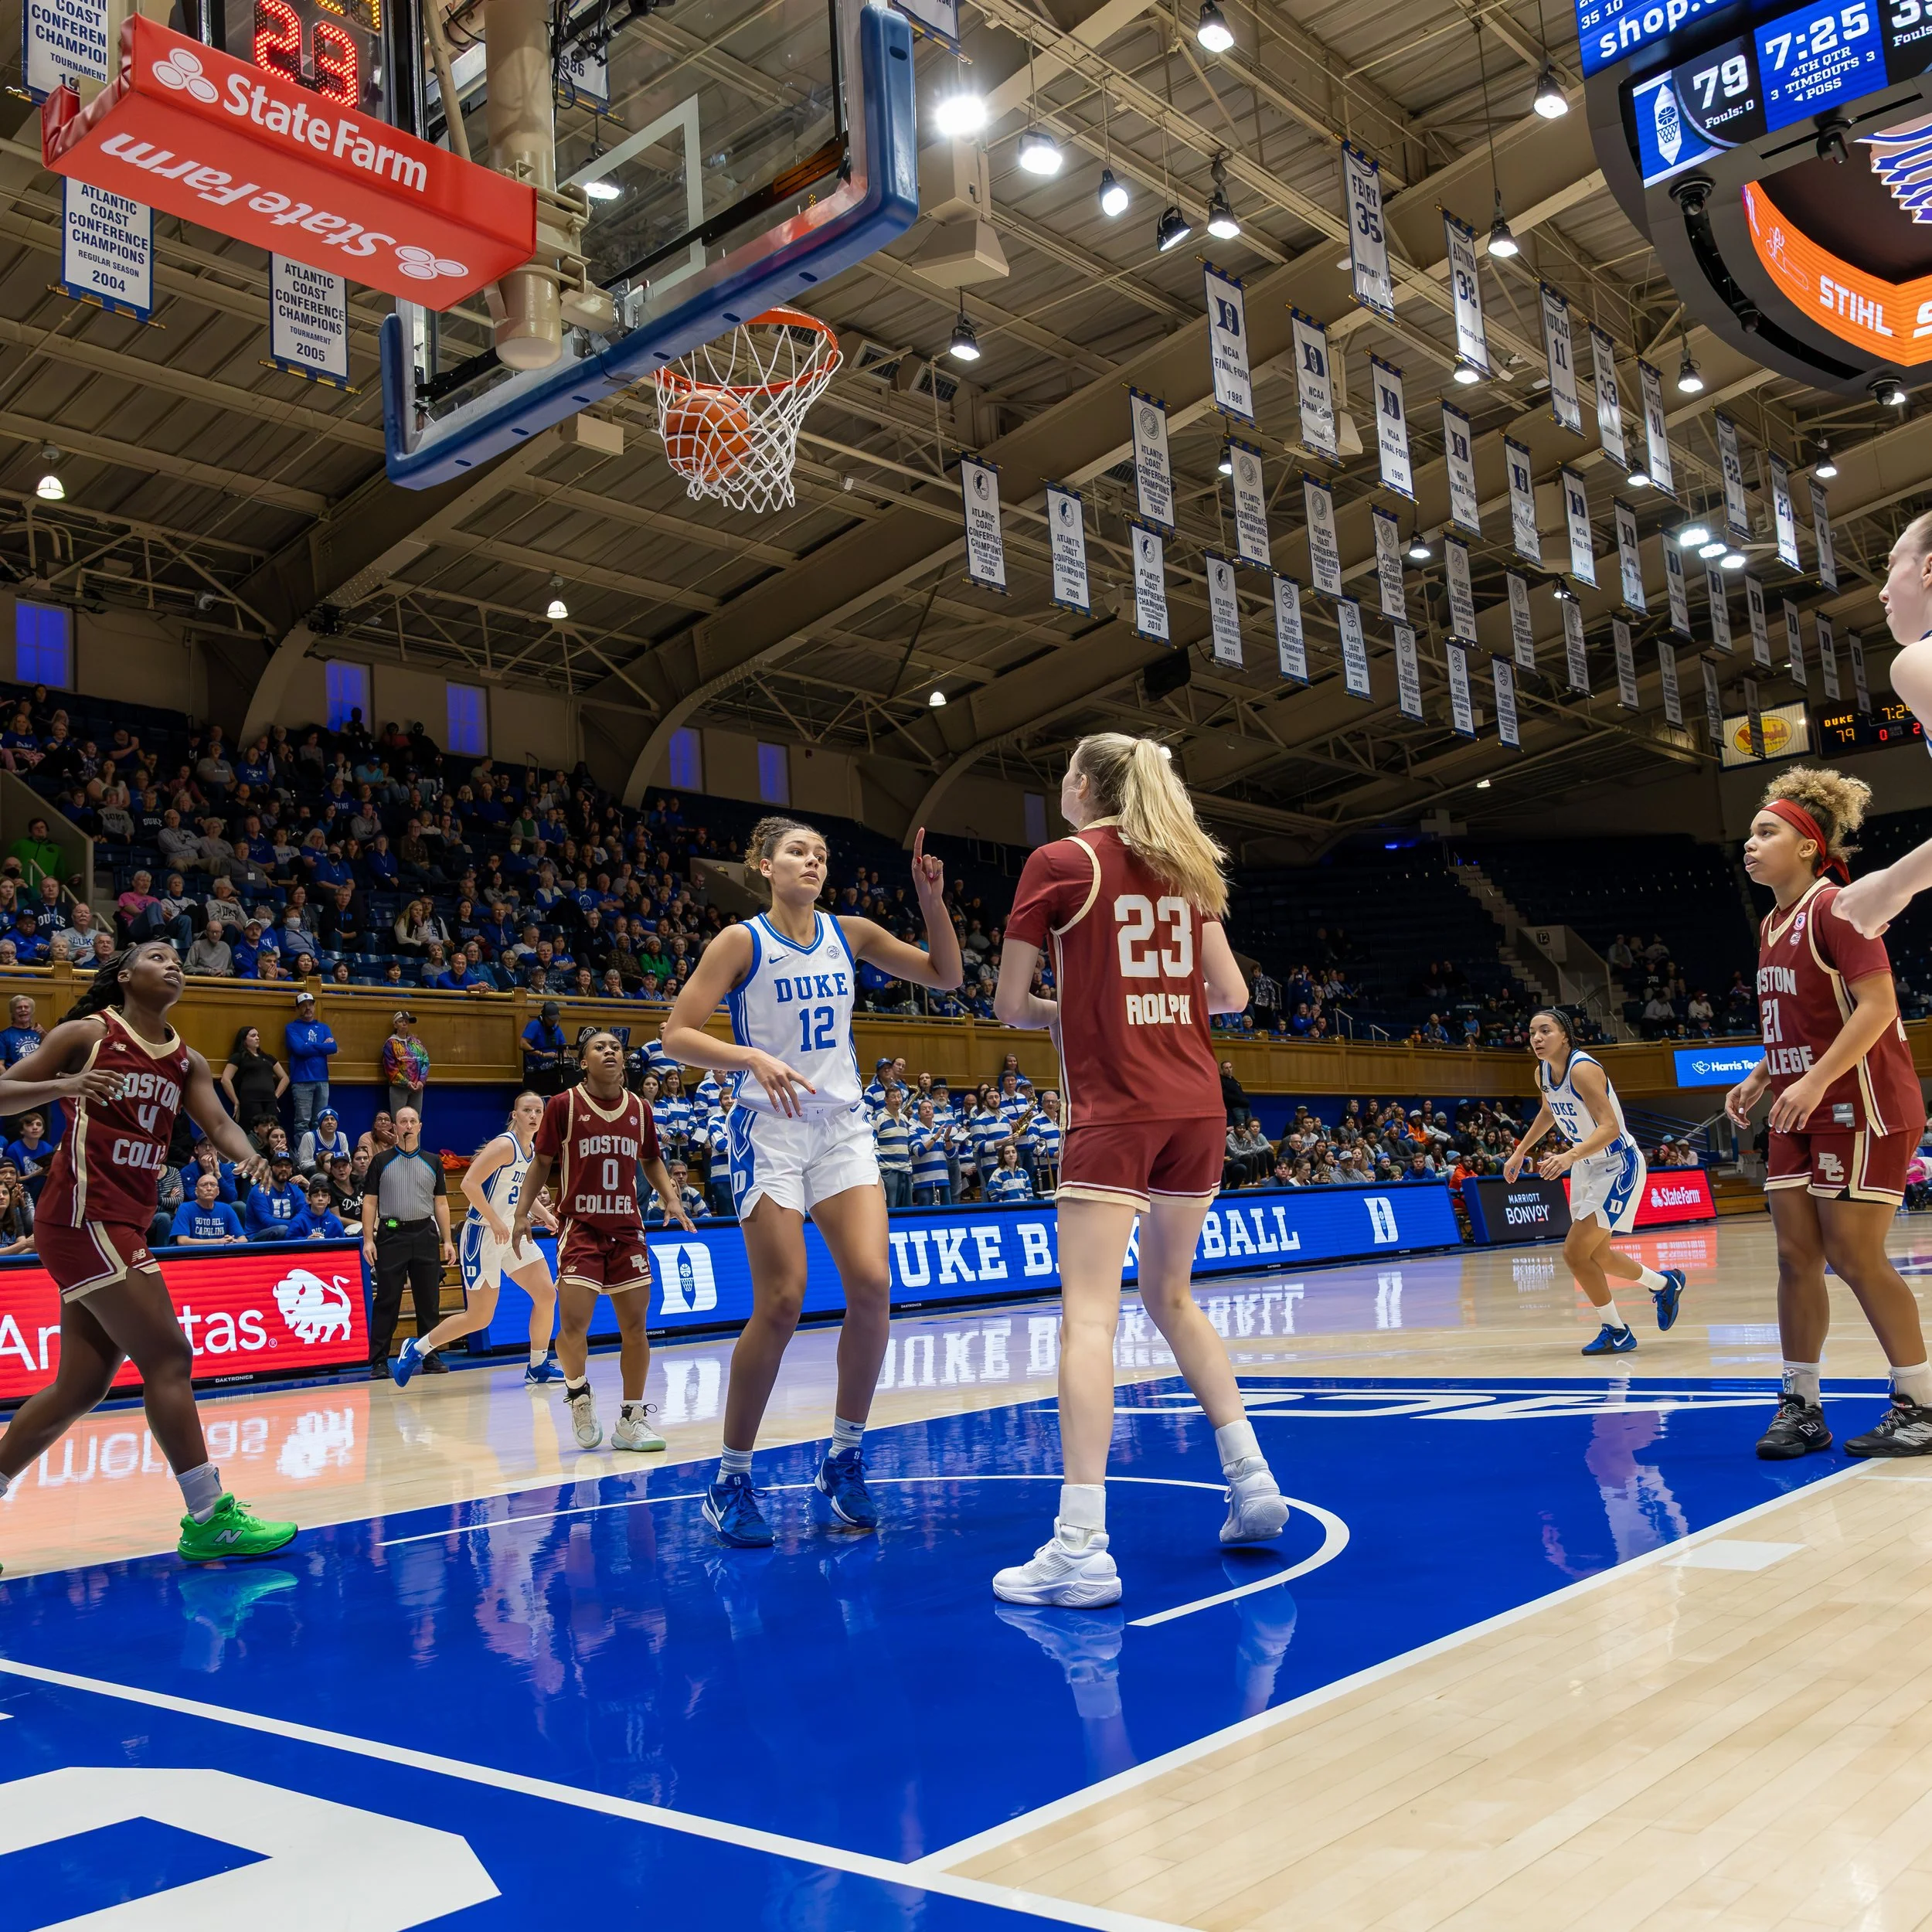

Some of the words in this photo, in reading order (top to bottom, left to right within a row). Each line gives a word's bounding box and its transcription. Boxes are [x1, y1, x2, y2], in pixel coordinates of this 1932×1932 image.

[56, 0, 101, 26] COAST
[1581, 14, 1600, 30] 35
[1765, 2, 1870, 71] 7:25
[50, 53, 107, 80] TOURNAMENT
[1791, 59, 1819, 77] 4TH
[1821, 46, 1852, 66] QTR
[1692, 54, 1750, 110] 79
[1770, 90, 1780, 100] 3
[1785, 58, 1859, 94] TIMEOUTS
[1866, 51, 1876, 63] 3
[1805, 79, 1842, 100] POSS
[1706, 104, 1743, 129] Fouls:
[1745, 99, 1754, 111] 0
[81, 184, 138, 215] ATLANTIC
[90, 202, 129, 227] COAST
[1355, 202, 1383, 243] 35
[69, 211, 148, 250] CONFERENCE
[72, 228, 145, 265] CHAMPIONS
[78, 250, 111, 267] REGULAR
[113, 261, 139, 277] SEASON
[92, 270, 126, 293] 2004
[284, 264, 335, 289] ATLANTIC
[292, 281, 327, 301] COAST
[1456, 270, 1478, 308] 32
[275, 288, 345, 321] CONFERENCE
[1819, 274, 1893, 337] STIHL
[278, 304, 342, 335] CHAMPIONS
[290, 325, 332, 345] TOURNAMENT
[296, 342, 325, 362] 2005
[1223, 345, 1240, 361] NCAA
[1553, 338, 1568, 370] 11
[1214, 358, 1233, 374] FINAL
[1226, 390, 1243, 405] 1988
[1308, 386, 1324, 400] NCAA
[1386, 427, 1400, 443] NCAA
[1141, 444, 1164, 462] ATLANTIC
[1145, 457, 1162, 471] COAST
[1138, 464, 1170, 485] CONFERENCE
[1391, 468, 1403, 481] 1990
[1141, 477, 1170, 496] CHAMPIONS
[1240, 490, 1260, 505] ATLANTIC
[971, 507, 995, 523] ATLANTIC
[1150, 504, 1165, 516] 1964
[1244, 502, 1258, 514] COAST
[976, 519, 993, 531] COAST
[1237, 509, 1267, 528] CONFERENCE
[968, 527, 1002, 546] CONFERENCE
[1056, 533, 1080, 548] ATLANTIC
[971, 538, 1002, 556] CHAMPIONS
[1062, 545, 1077, 558] COAST
[1250, 545, 1263, 557] 1965
[1053, 553, 1086, 570] CONFERENCE
[1056, 563, 1085, 580] CHAMPIONS
[1140, 568, 1160, 583] ATLANTIC
[1145, 579, 1158, 591] COAST
[1066, 588, 1079, 599] 2009
[1215, 597, 1234, 610] ATLANTIC
[1148, 620, 1162, 631] 2010
[1224, 646, 1236, 656] 2011
[1825, 715, 1853, 727] DUKE
[1836, 729, 1855, 743] 79
[1114, 894, 1194, 978] 23
[774, 972, 849, 1003] DUKE
[1126, 993, 1192, 1025] ROLPH
[799, 1005, 836, 1052] 12
[1762, 998, 1783, 1044] 21
[1710, 1061, 1742, 1072] Harris
[138, 1104, 160, 1134] 4
[578, 1134, 638, 1161] BOSTON
[603, 1159, 619, 1191] 0
[575, 1194, 634, 1214] COLLEG
[1508, 1192, 1540, 1204] MARRIOTT
[1506, 1204, 1549, 1225] BONVOY
[889, 1226, 1009, 1288] UKE
[215, 1374, 253, 1383] DAKTRONICS
